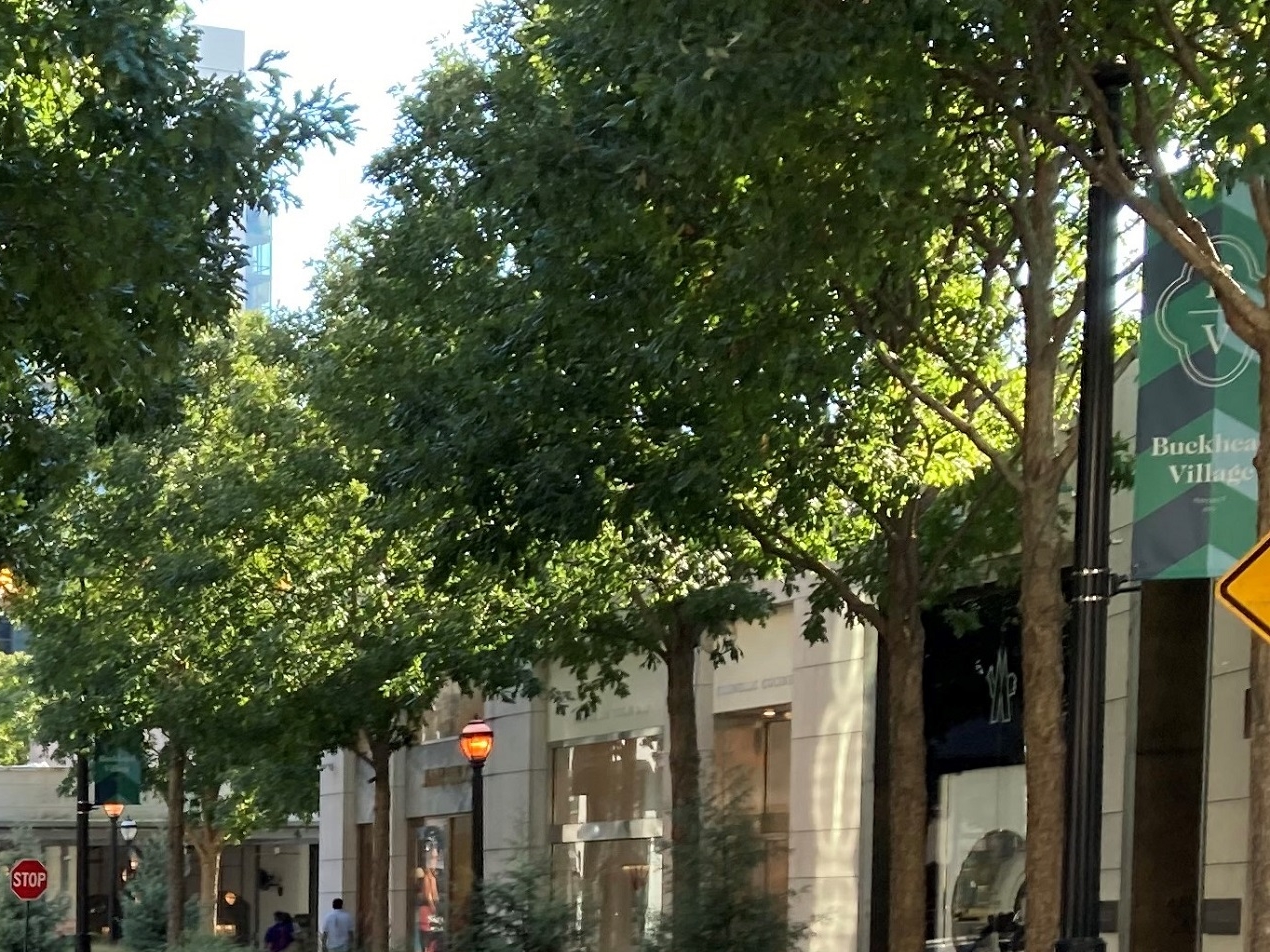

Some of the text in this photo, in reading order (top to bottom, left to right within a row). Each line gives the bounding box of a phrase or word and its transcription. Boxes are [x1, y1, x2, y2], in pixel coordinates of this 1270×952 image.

[1151, 433, 1260, 457] Buckhea
[1168, 463, 1255, 487] Village
[12, 871, 46, 888] STOP
